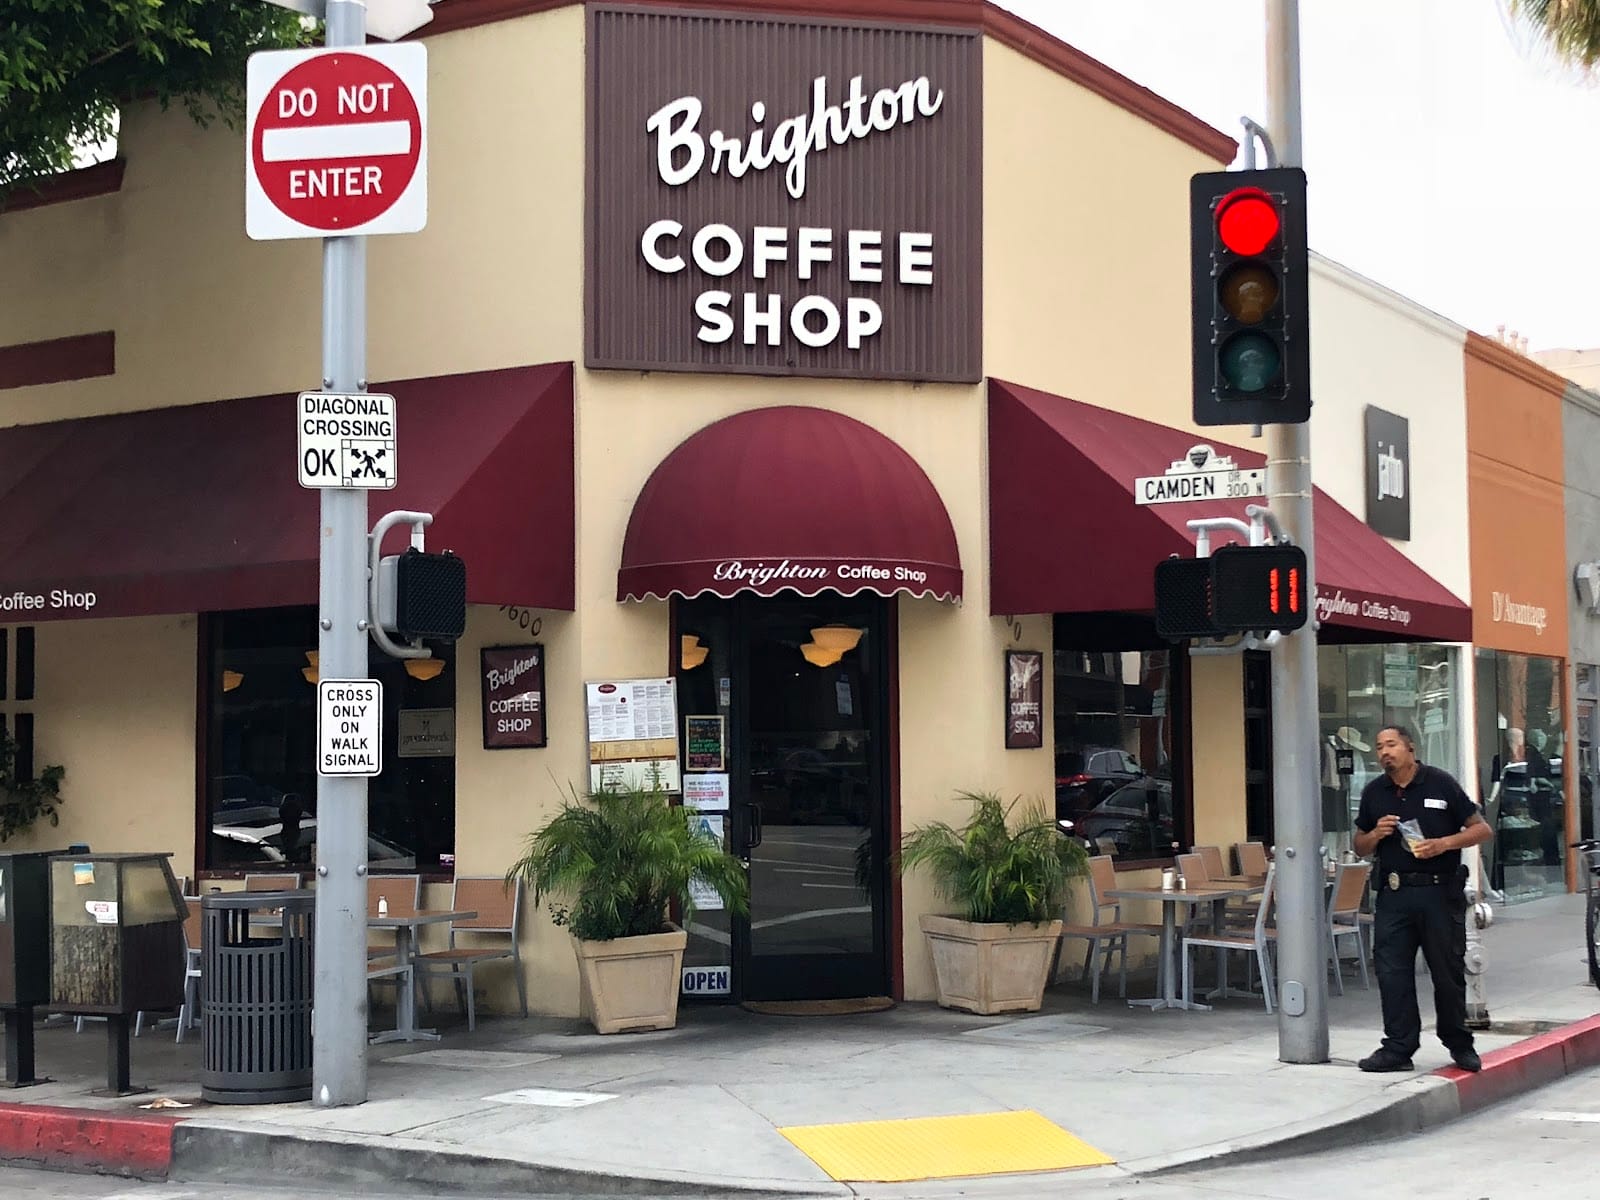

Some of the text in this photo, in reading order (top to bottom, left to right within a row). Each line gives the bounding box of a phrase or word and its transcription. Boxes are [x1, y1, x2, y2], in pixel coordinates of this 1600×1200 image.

[278, 82, 395, 119] DO NOT
[646, 76, 944, 199] Brighton
[289, 165, 383, 199] ENTER
[641, 219, 933, 285] COFFEE
[695, 289, 883, 350] SHOP
[304, 398, 389, 415] DIAGONAL
[303, 419, 392, 437] CROSSING
[304, 448, 338, 477] OK
[1145, 476, 1215, 501] CAMDEN
[1226, 482, 1249, 497] 300
[713, 559, 927, 586] Brighton Coffee Shop
[0, 589, 96, 611] offee Shop
[1269, 567, 1299, 614] 11
[499, 604, 542, 637] 600
[1361, 600, 1389, 620] Coffee
[1389, 604, 1411, 627] Shop
[486, 655, 539, 692] Brighton
[327, 689, 373, 701] CROSS
[489, 699, 539, 714] COFFEE
[332, 705, 367, 718] ONLY
[341, 721, 359, 734] ON
[497, 718, 532, 733] SHOP
[331, 737, 368, 750] WALK
[325, 753, 375, 767] SIGNAL
[684, 971, 728, 991] OPEN
